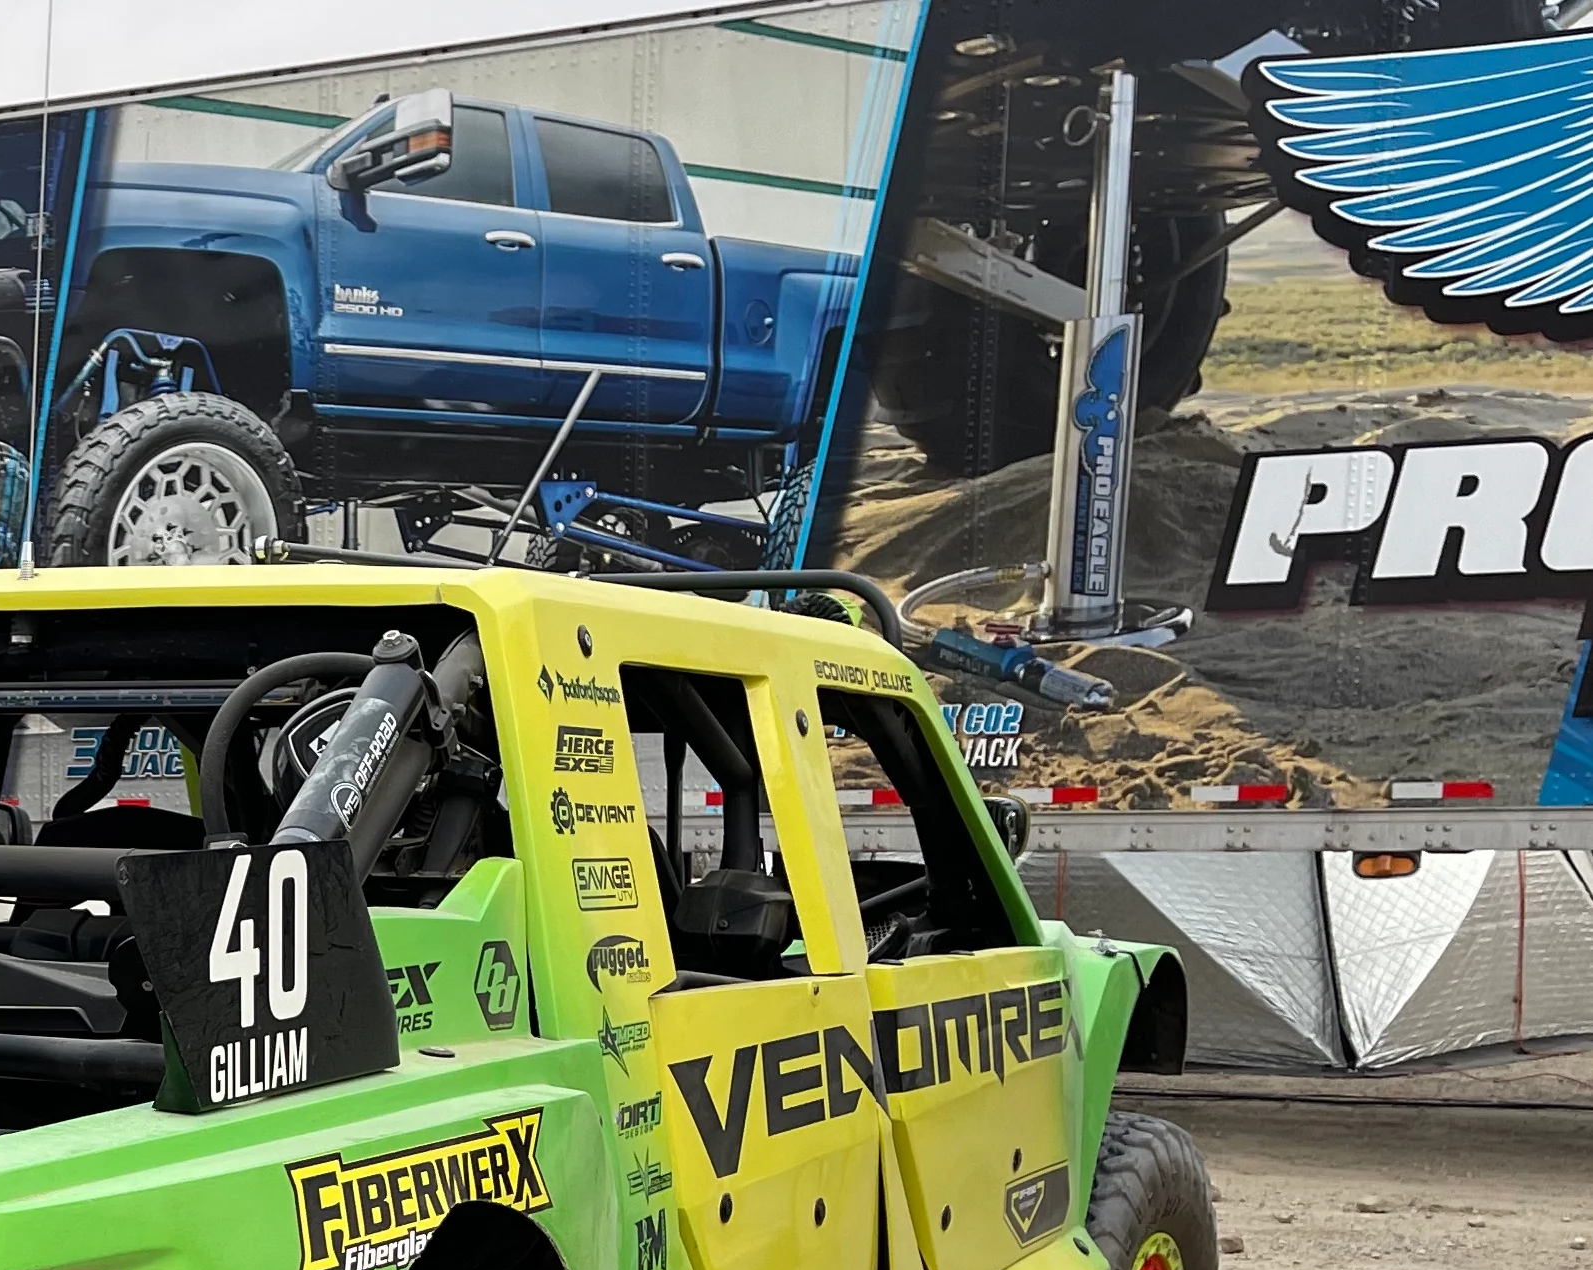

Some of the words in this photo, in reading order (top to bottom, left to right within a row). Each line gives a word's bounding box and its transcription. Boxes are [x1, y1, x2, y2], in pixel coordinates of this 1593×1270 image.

[334, 284, 379, 304] banks
[334, 303, 377, 314] 2500
[380, 306, 403, 316] HD
[1094, 436, 1115, 496] PRO
[1088, 500, 1111, 592] EAGLE
[814, 660, 912, 692] @COWBOY_DELUXE
[963, 702, 1024, 735] CO2
[125, 727, 182, 752] ON
[556, 725, 614, 755] FIERCE
[963, 737, 1023, 767] JACK
[554, 757, 599, 772] SXS
[574, 803, 635, 823] DEVIANT
[577, 865, 632, 890] SAVAGE
[617, 891, 633, 901] UTV
[209, 849, 307, 1029] 40
[211, 1027, 307, 1103] GILLIAM
[620, 1091, 661, 1131] DIRT
[301, 1124, 543, 1262] FIBERWERX
